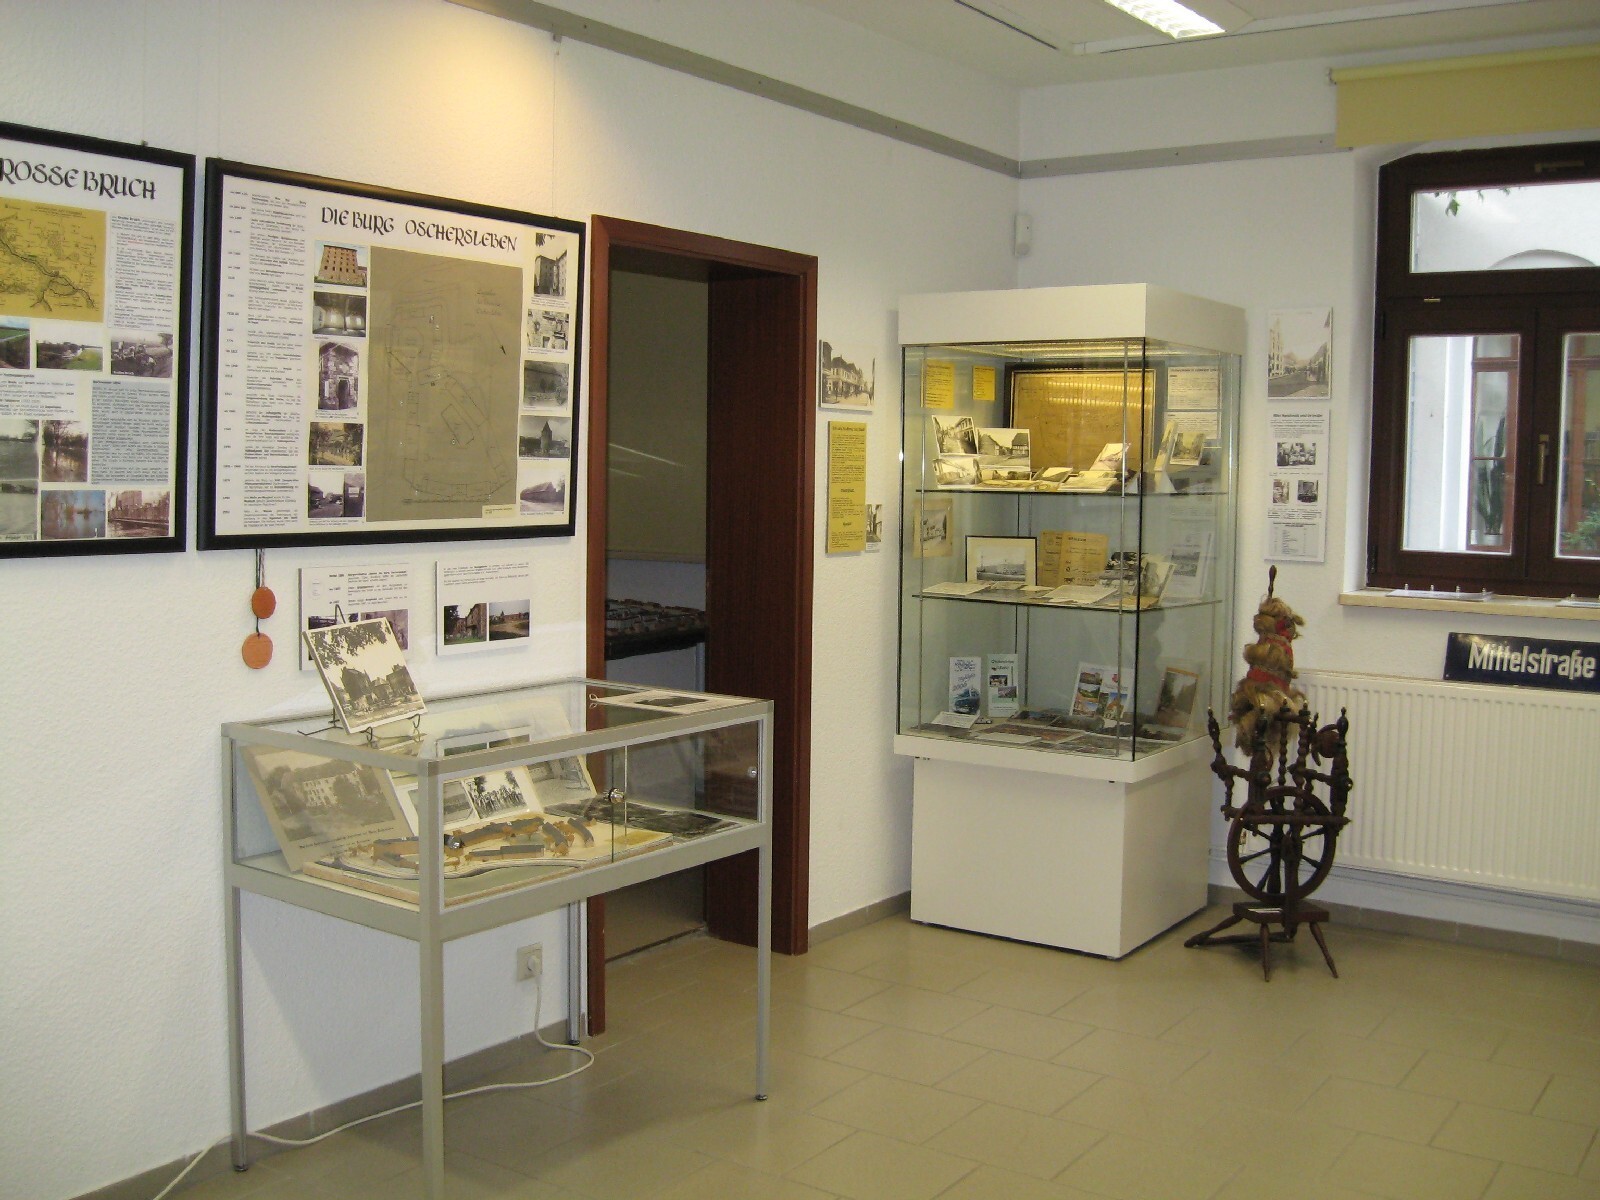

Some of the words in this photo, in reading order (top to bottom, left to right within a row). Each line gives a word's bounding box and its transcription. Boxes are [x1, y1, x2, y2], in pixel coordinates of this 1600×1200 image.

[83, 169, 156, 200] BRUCH
[321, 207, 349, 225] DIE
[352, 211, 394, 236] BURG
[405, 219, 518, 251] OSCHERSLEBEN
[1468, 641, 1597, 680] Mittelstraße
